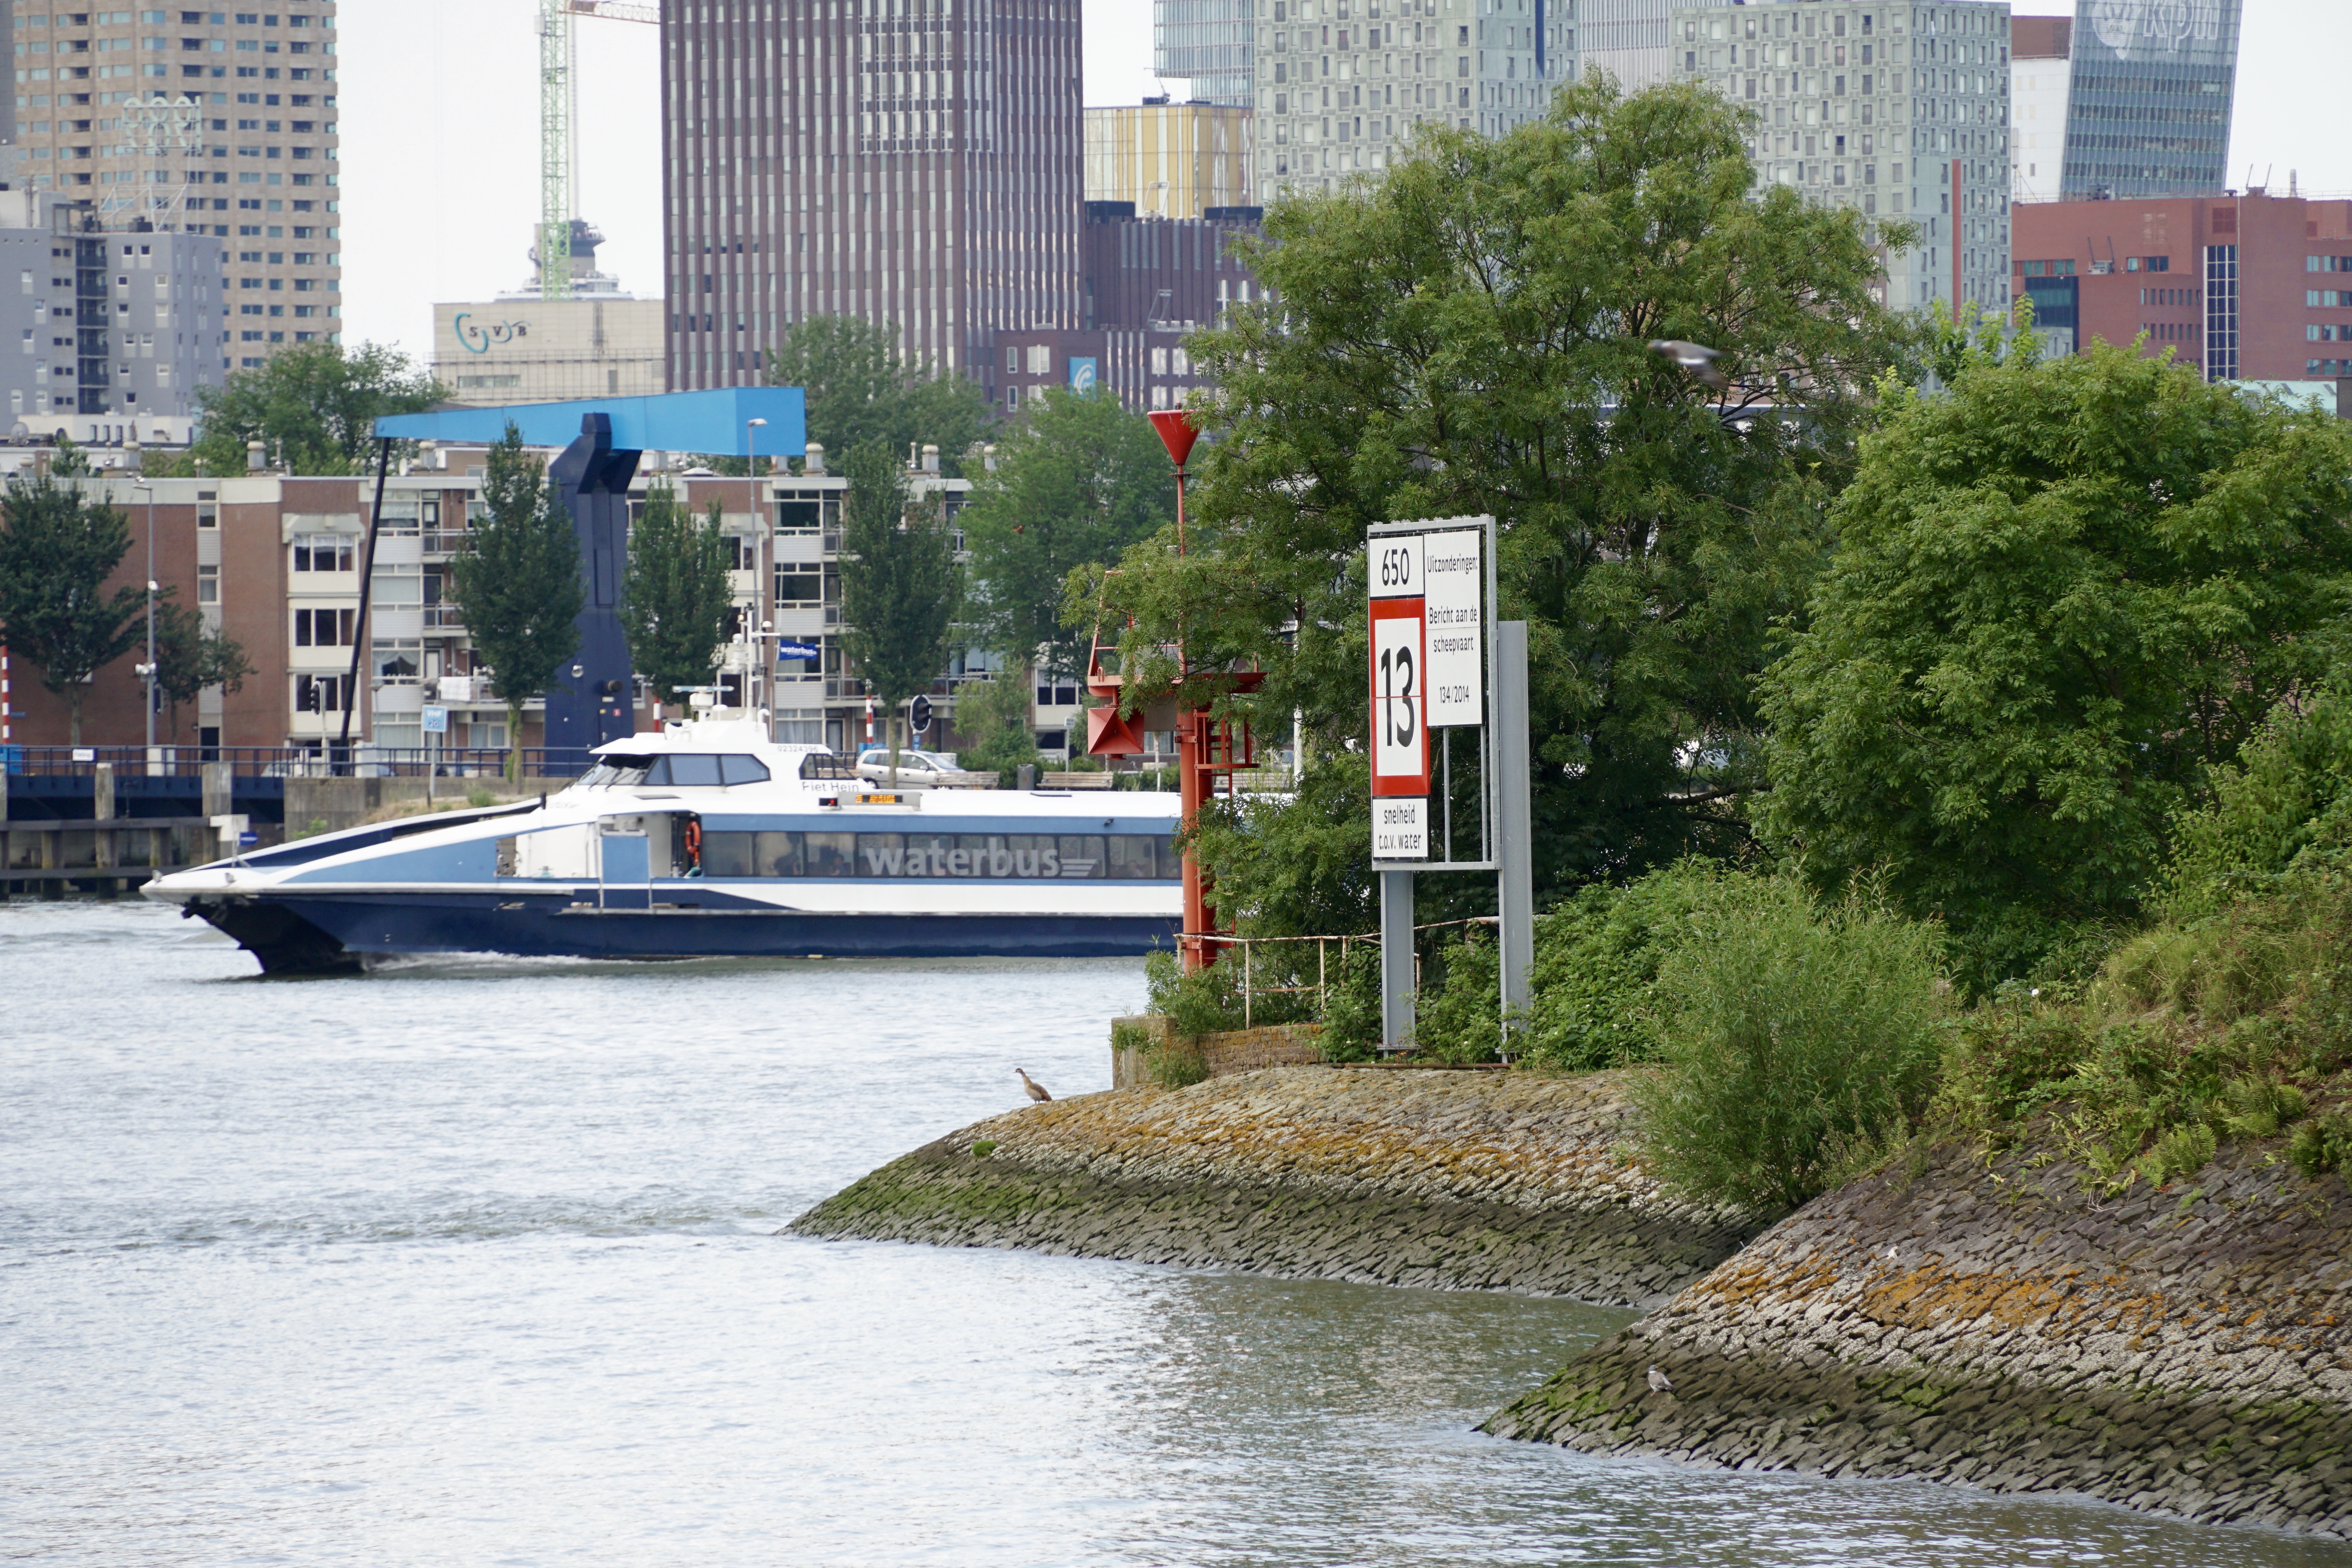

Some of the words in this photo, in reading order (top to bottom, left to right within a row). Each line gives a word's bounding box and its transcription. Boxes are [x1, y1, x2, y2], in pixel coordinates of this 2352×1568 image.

[2143, 0, 2220, 53] kpn
[1382, 548, 1410, 586] 650
[1427, 553, 1478, 575] Uitzonderingen:
[1429, 606, 1454, 624] Bericht
[1455, 609, 1468, 623] aan
[1470, 604, 1477, 622] de
[1433, 635, 1474, 655] scheepvaart
[1380, 646, 1415, 748] 13
[1439, 685, 1470, 704] 134/2014
[830, 782, 859, 792] Hein
[1384, 804, 1415, 824] snelheid
[1379, 833, 1396, 850] t.o.v.
[1398, 832, 1421, 849] water
[866, 837, 1059, 877] waterbus
